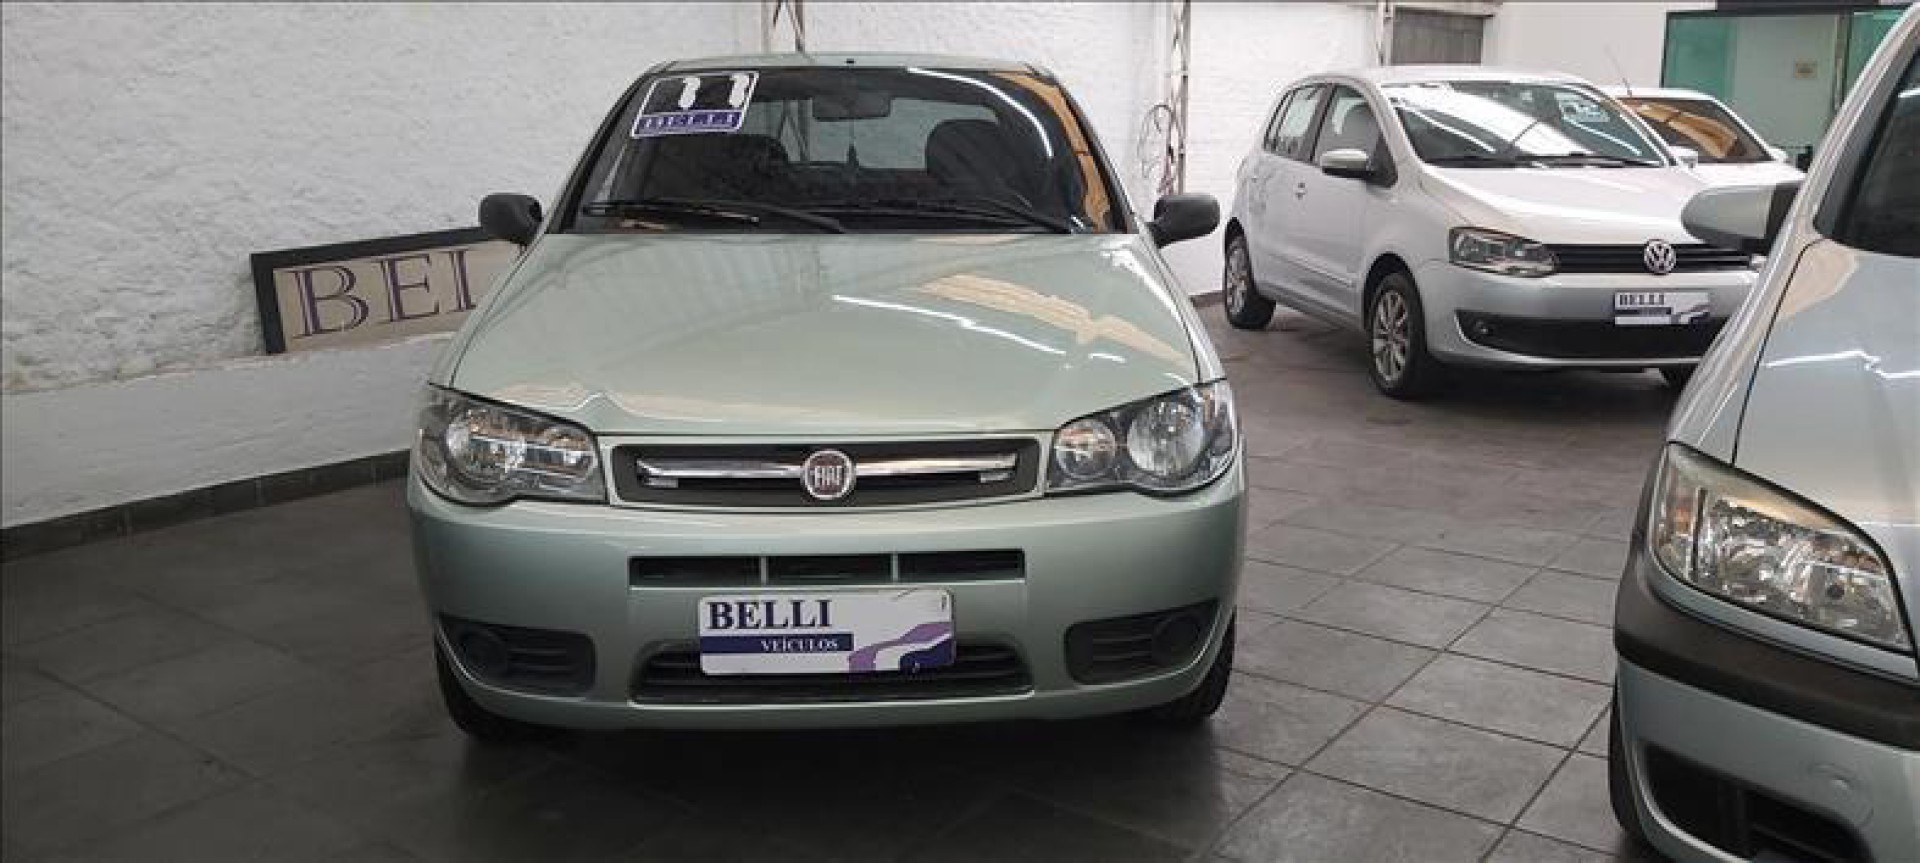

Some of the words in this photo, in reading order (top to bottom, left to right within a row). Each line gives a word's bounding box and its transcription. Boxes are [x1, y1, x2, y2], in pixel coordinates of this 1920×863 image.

[1619, 294, 1665, 306] BELLI
[814, 465, 843, 488] FIAT
[707, 600, 832, 629] BELLI
